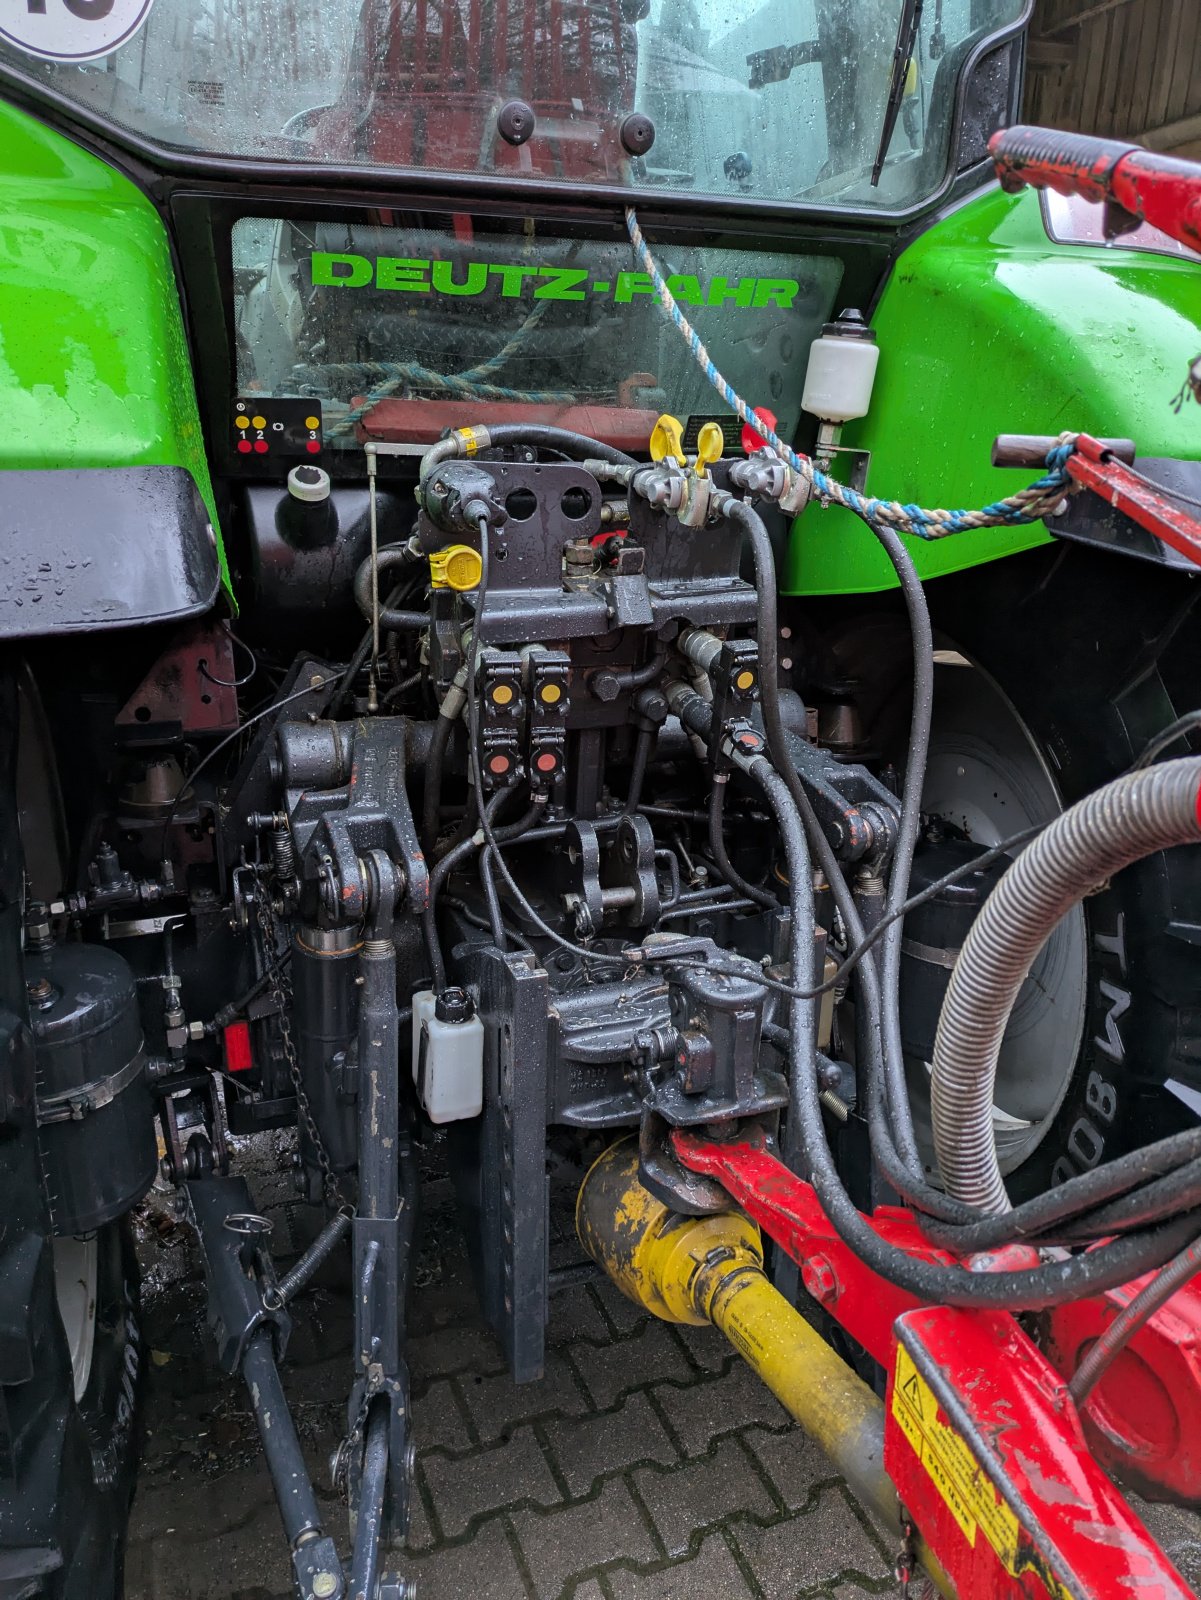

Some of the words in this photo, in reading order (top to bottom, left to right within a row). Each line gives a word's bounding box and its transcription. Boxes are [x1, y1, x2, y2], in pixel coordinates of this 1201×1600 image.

[312, 251, 799, 308] DEUTZ-FAHR
[240, 430, 246, 439] 1
[256, 430, 264, 439] 2
[309, 431, 317, 440] 3
